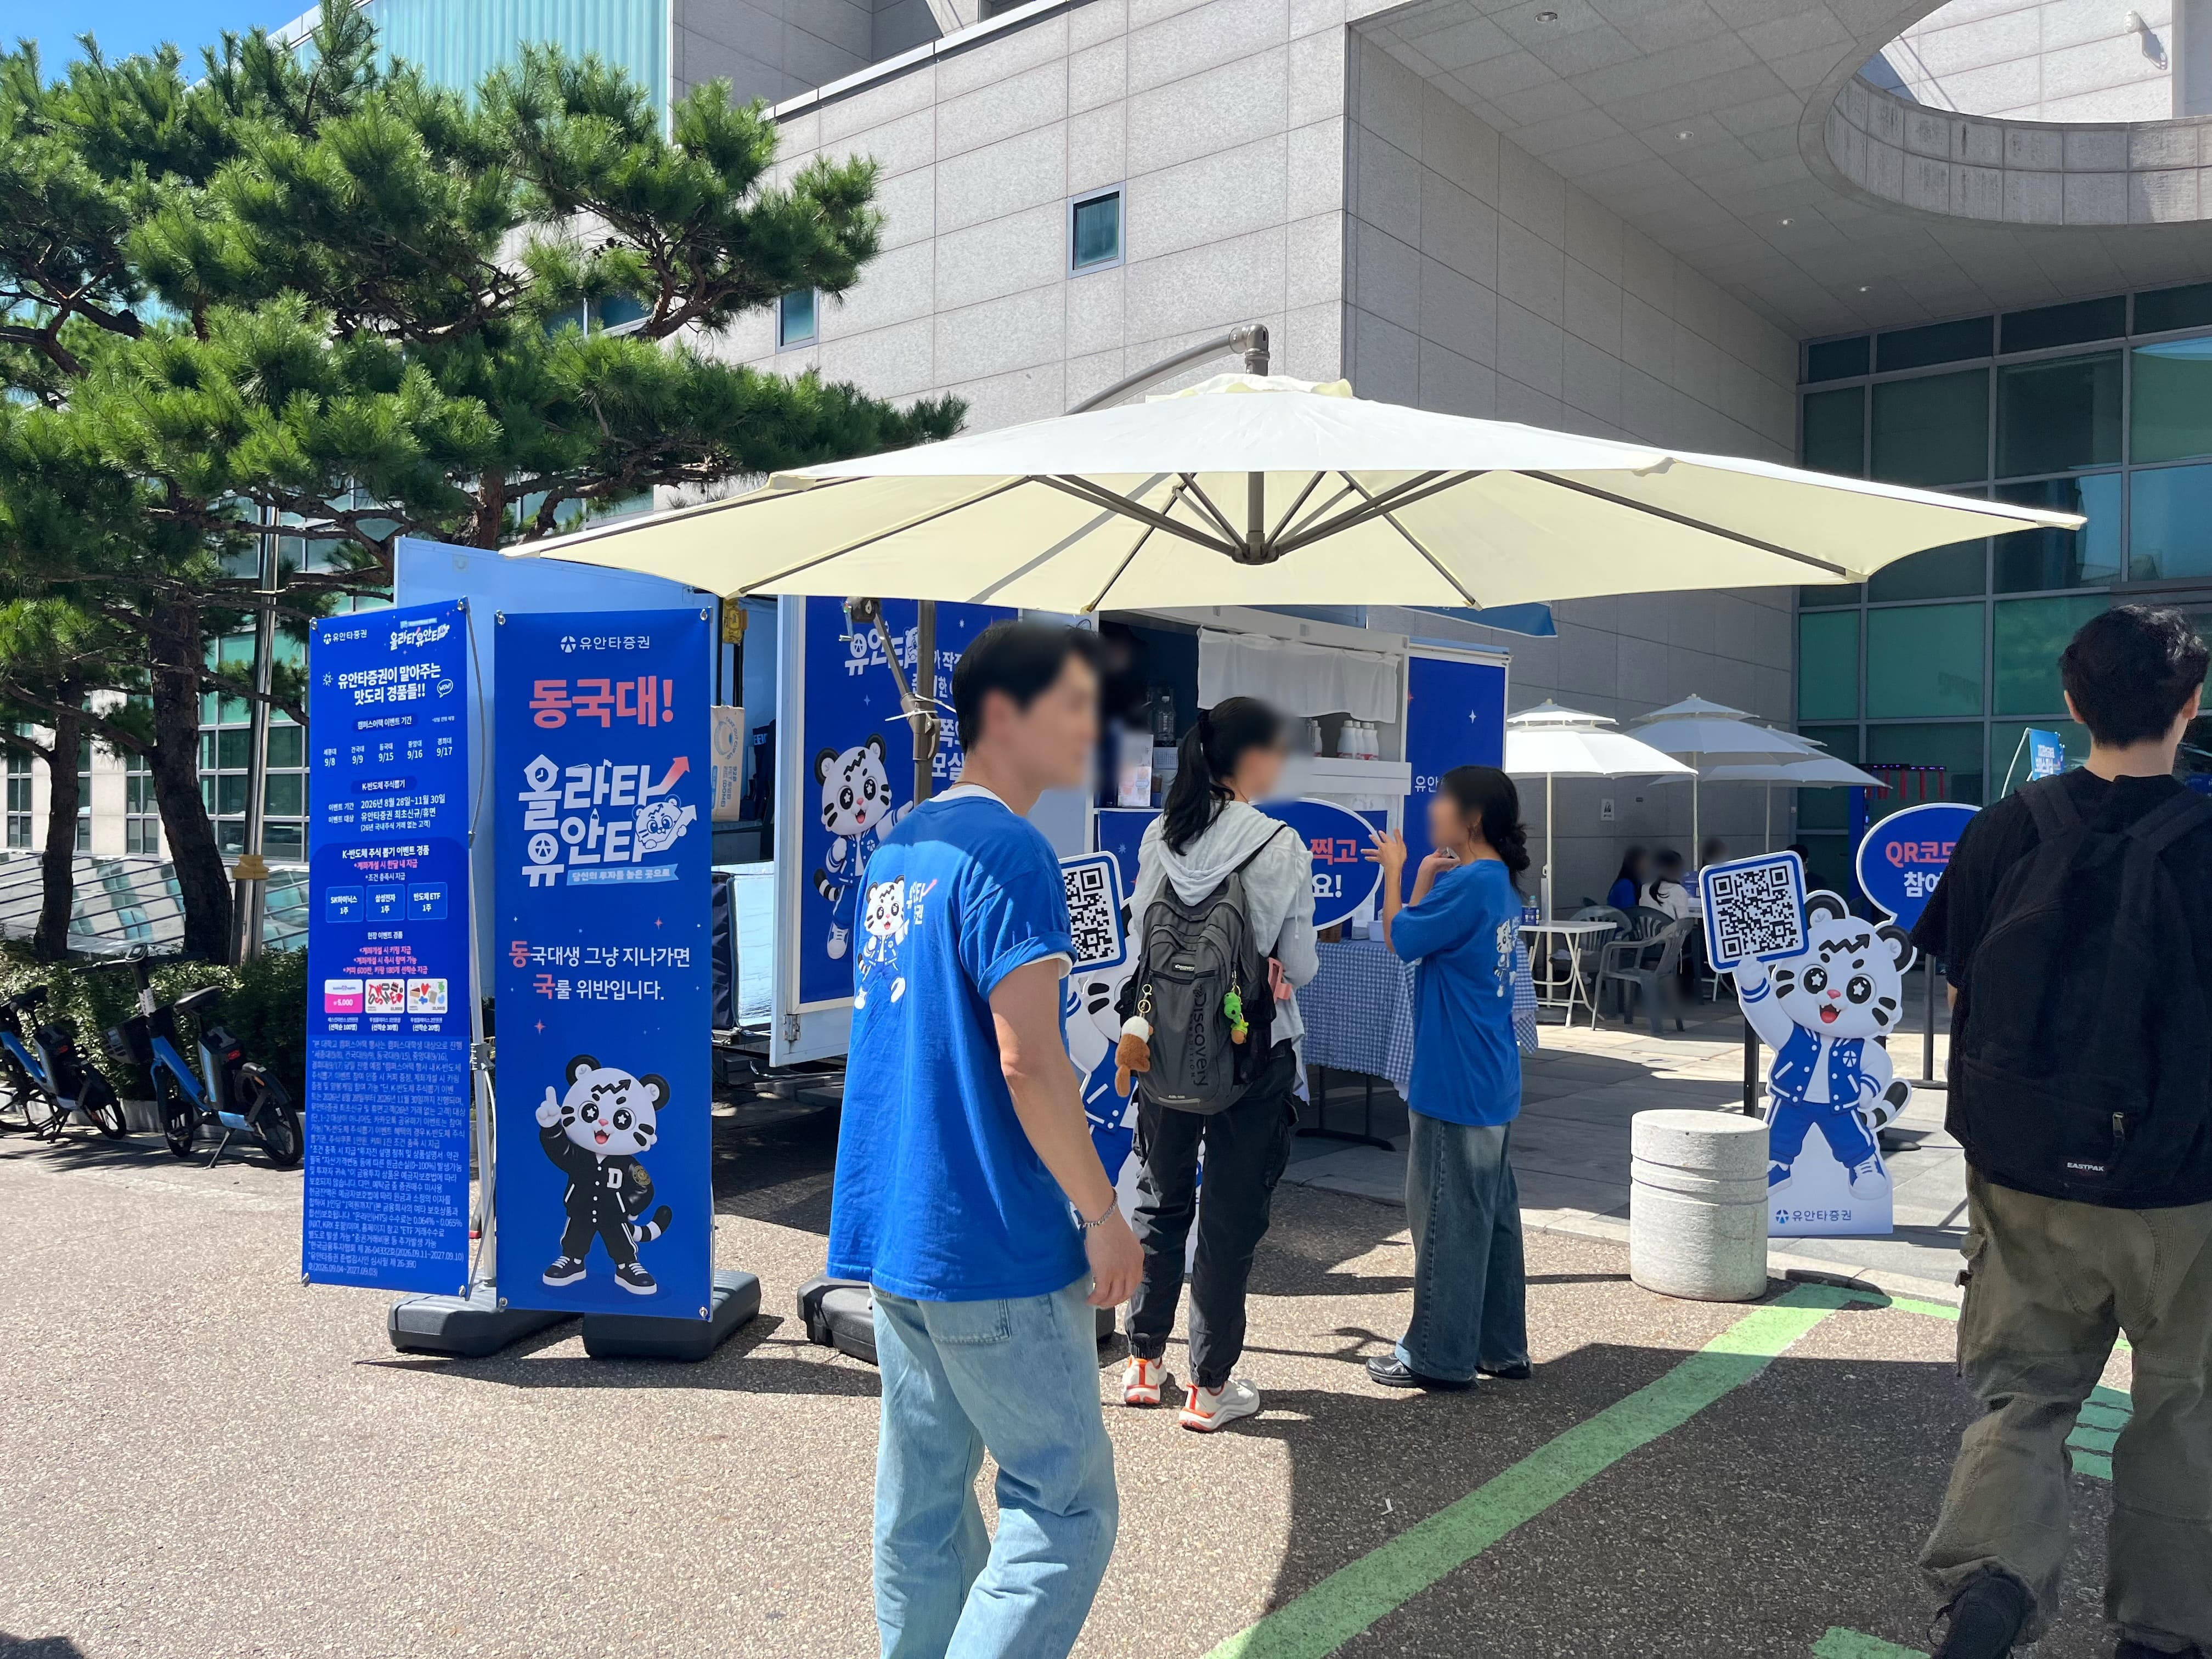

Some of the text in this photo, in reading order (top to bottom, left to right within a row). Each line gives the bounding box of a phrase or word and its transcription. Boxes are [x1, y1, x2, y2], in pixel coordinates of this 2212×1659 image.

[332, 630, 367, 642] 유안타증권
[580, 636, 650, 650] 유안타증권
[338, 662, 441, 689] 유안타증권이 말아주는
[354, 683, 425, 706] 맛도리 경품들!!
[529, 675, 673, 729] 동국대!
[358, 716, 411, 730] 캠퍼스어택 이벤트 기간
[379, 752, 393, 763] 9/15
[407, 749, 422, 760] 9/16
[437, 747, 452, 757] 9/17
[325, 758, 335, 768] 9/8
[352, 755, 363, 765] 9/9
[362, 780, 405, 791] K-반도체 주식뽑기
[1415, 776, 1438, 793] 유안
[518, 754, 652, 831] 올라타
[329, 794, 445, 811] 이벤트 기간 2026년 8월 28일~11월 30일
[344, 815, 354, 823] 대상
[361, 810, 393, 822] 유안타증권
[394, 808, 436, 819] 최초신규/휴면
[360, 824, 373, 832] (26년
[375, 822, 394, 831] 국내주식
[418, 820, 431, 828] 고객)
[342, 845, 430, 859] K-반도체 주식 뽑기 이벤트 경품
[522, 808, 646, 887] 유안타
[1310, 838, 1358, 865] 찍고
[380, 861, 386, 869] 시
[400, 860, 405, 868] 내
[407, 859, 418, 868] 지급
[572, 869, 670, 882] 당신의 투자를 높은 곳으로
[331, 895, 357, 904] SK하이닉스
[375, 894, 396, 902] 삼성전자
[414, 893, 430, 901] 반도체
[340, 907, 348, 915] 1주
[381, 905, 390, 913] 1주
[422, 904, 431, 912] 1주
[401, 946, 411, 955] 지급
[509, 941, 690, 968] 동국대생 그냥 지나가면
[417, 966, 428, 974] 지급
[533, 974, 664, 1000] 국룰 위반입니다.
[426, 1128, 450, 1138] K-반도체
[452, 1129, 465, 1138] 주식
[421, 1138, 426, 1147] 시
[428, 1139, 439, 1148] 지급
[405, 1149, 411, 1158] 및
[447, 1152, 459, 1161] 약관
[438, 1164, 462, 1172] 발생가능
[2067, 1163, 2104, 1171] EASTPAK
[607, 1167, 623, 1189] D
[1792, 1210, 1852, 1222] 유안타증권
